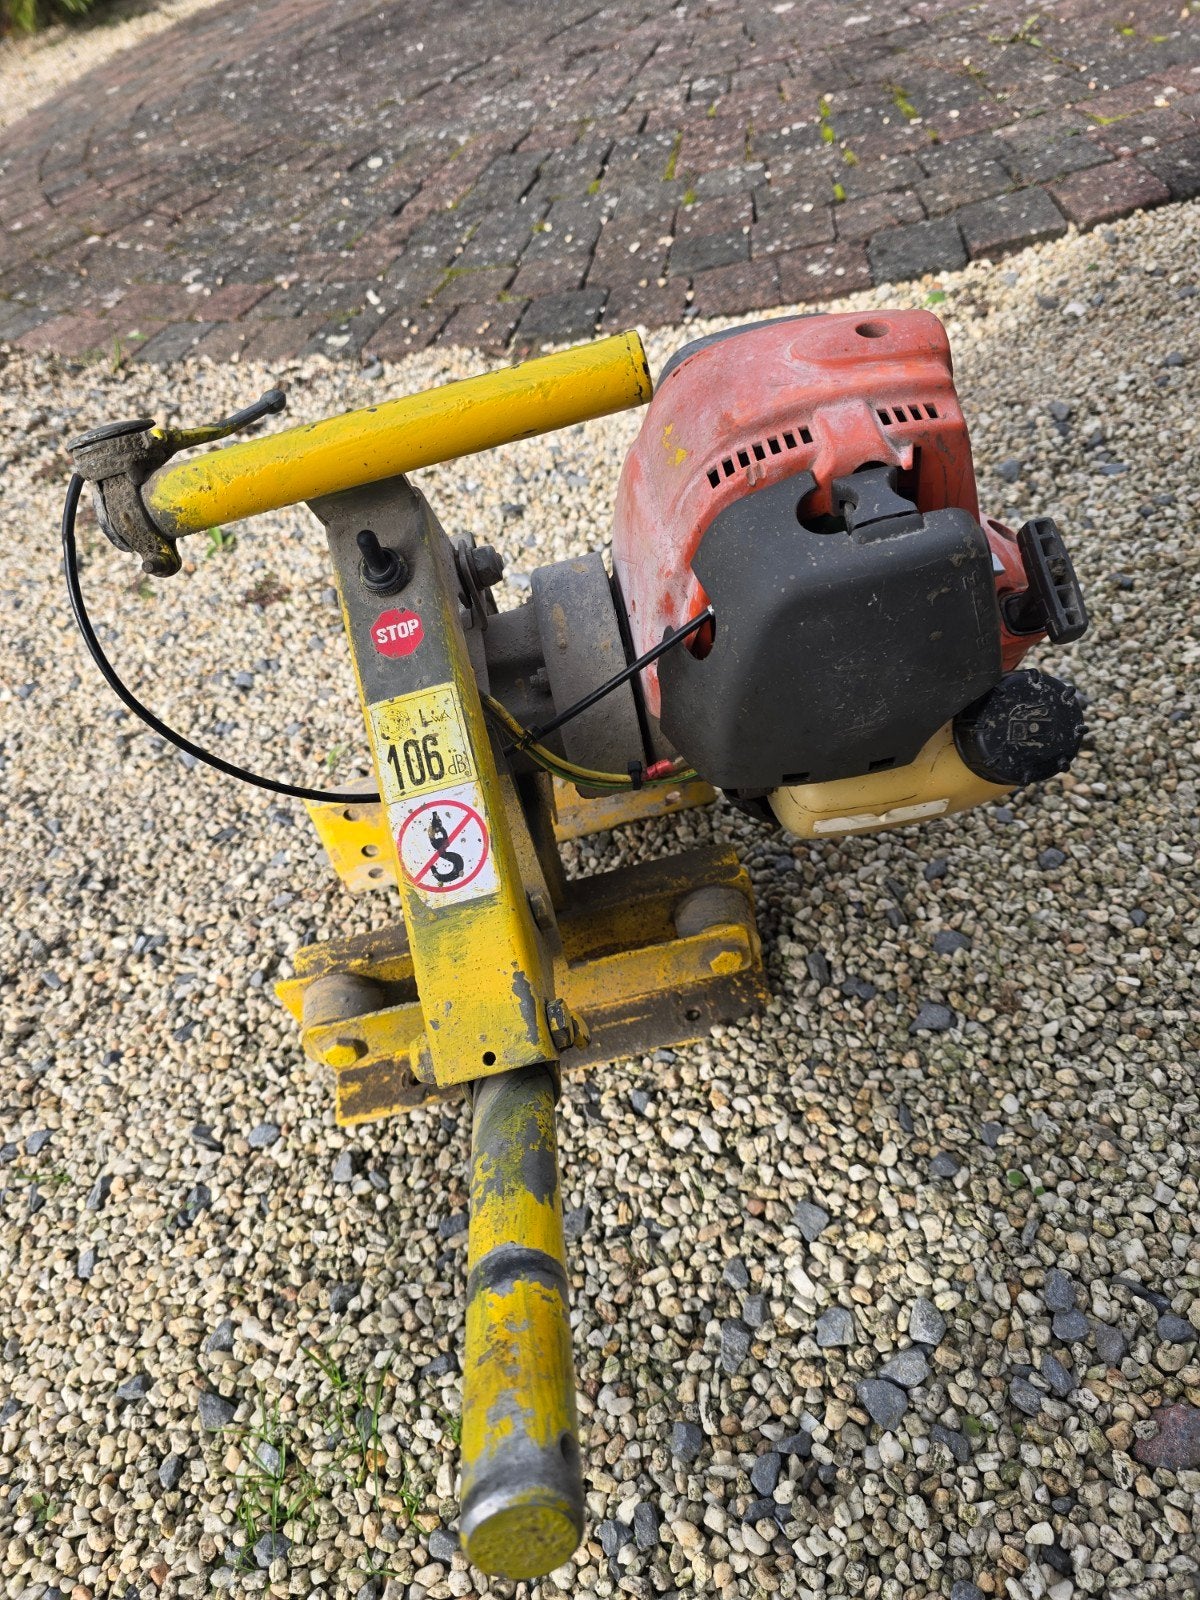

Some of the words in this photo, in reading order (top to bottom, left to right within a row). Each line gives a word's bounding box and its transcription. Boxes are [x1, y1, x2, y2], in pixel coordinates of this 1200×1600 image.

[376, 618, 419, 644] STOP
[387, 733, 445, 790] 106
[447, 754, 467, 775] dB
